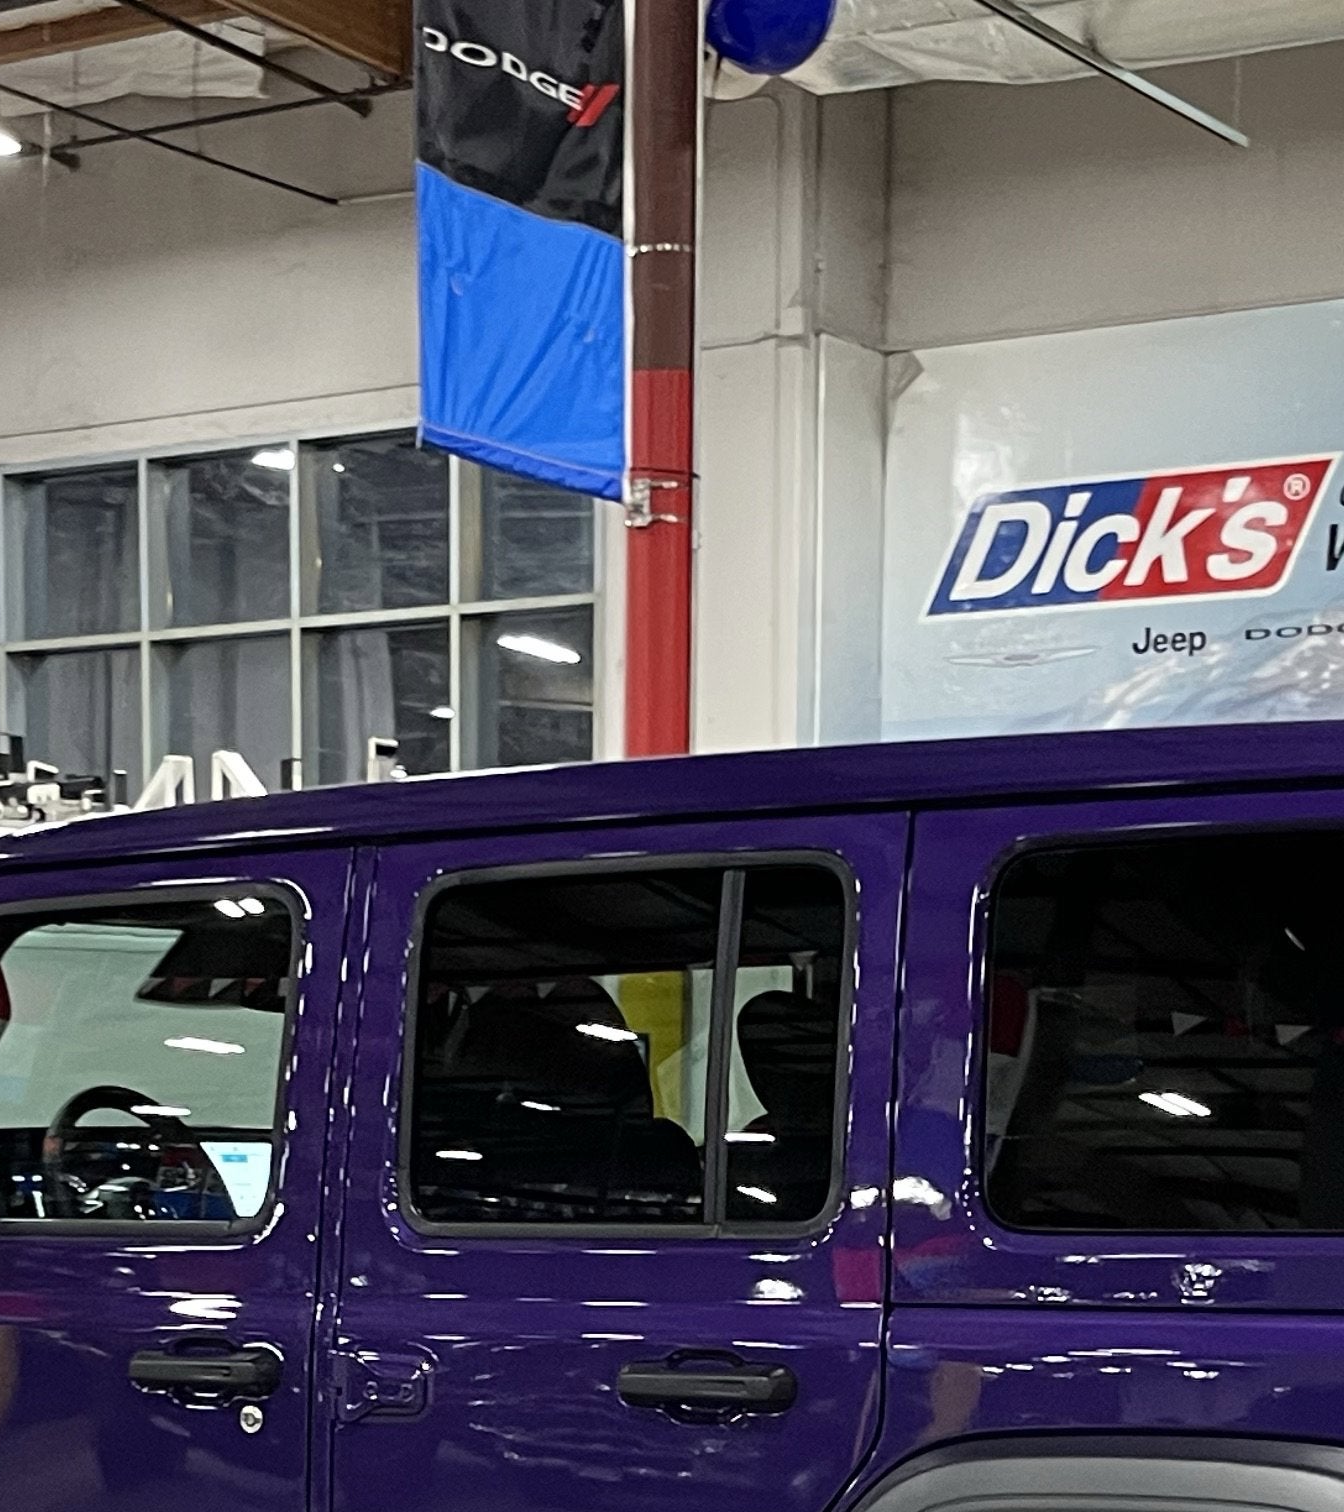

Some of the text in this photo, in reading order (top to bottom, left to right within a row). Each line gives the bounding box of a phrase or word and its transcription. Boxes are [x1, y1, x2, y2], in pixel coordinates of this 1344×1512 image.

[422, 26, 585, 112] DODGE
[948, 476, 1289, 602] Dick's
[1131, 626, 1207, 657] Jeep
